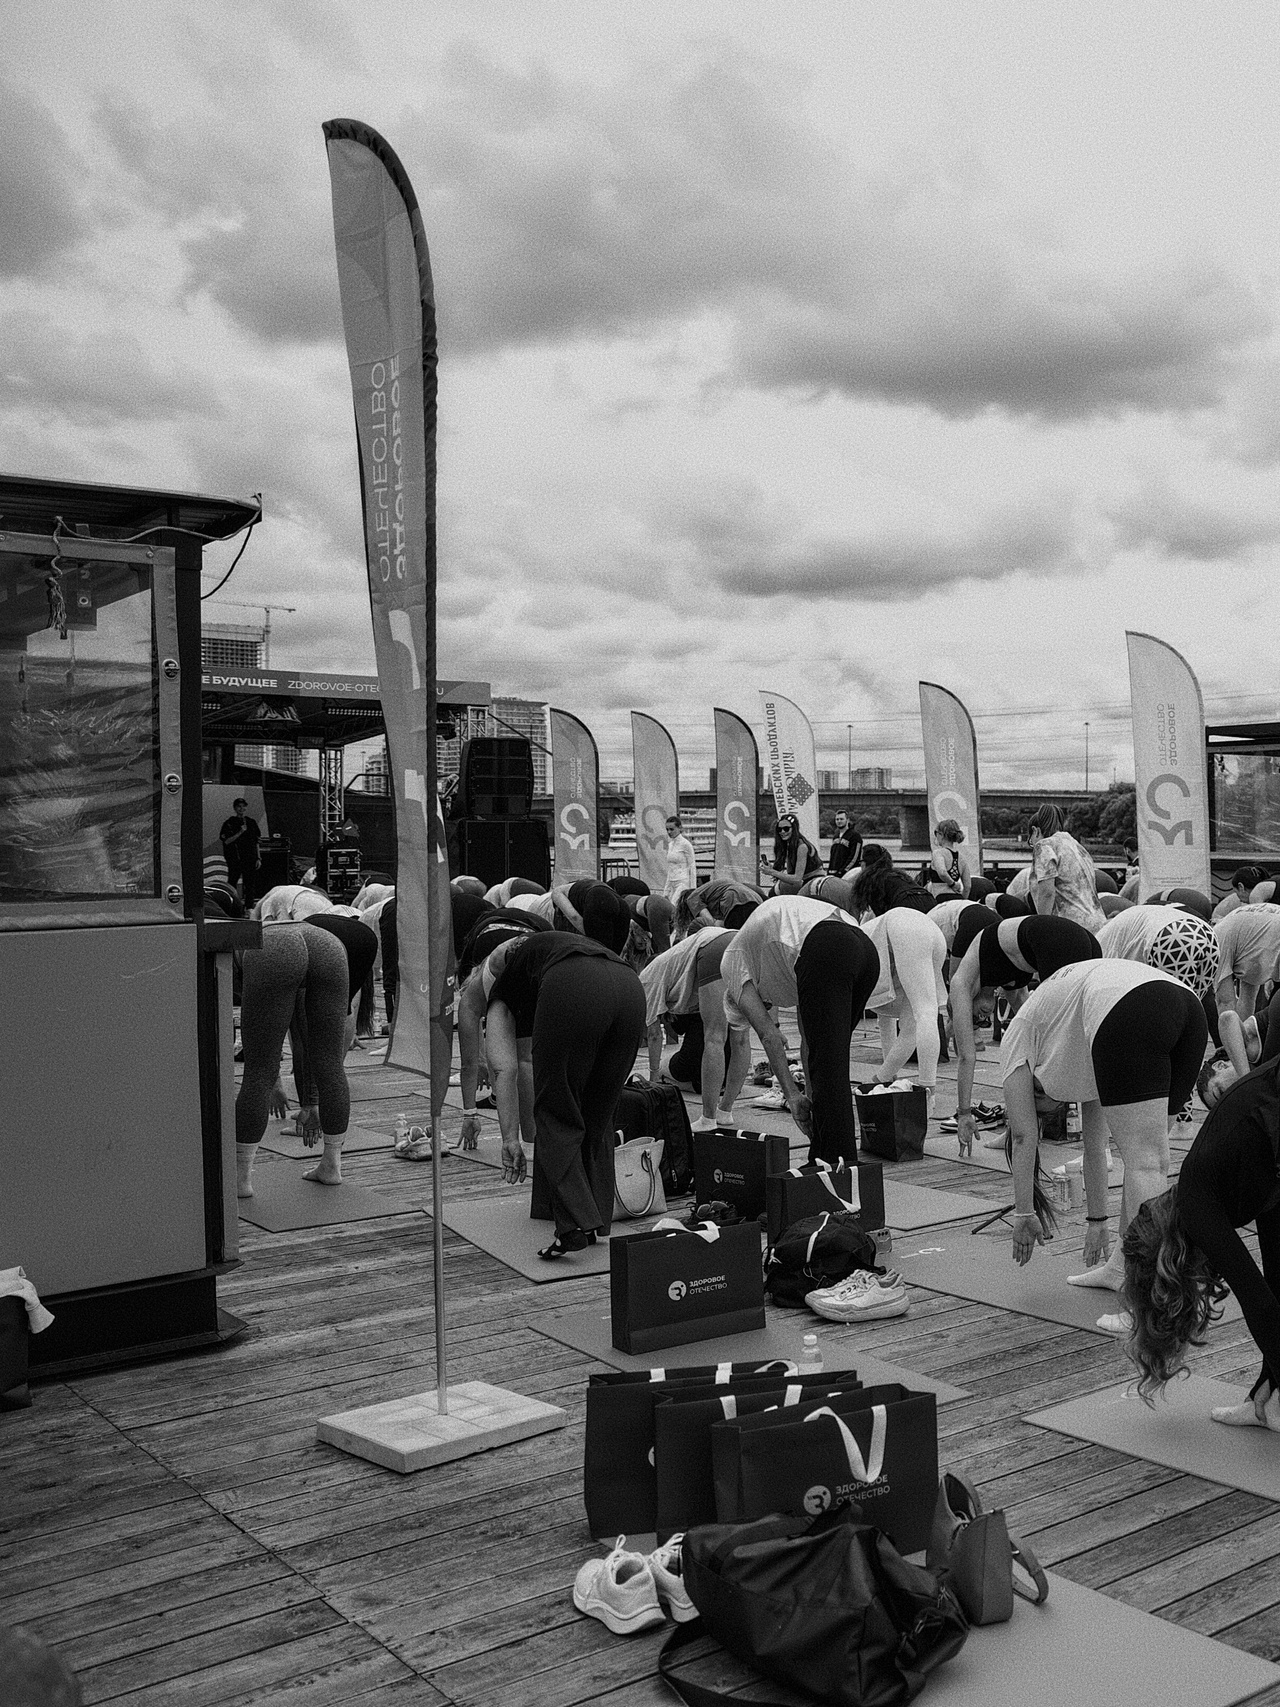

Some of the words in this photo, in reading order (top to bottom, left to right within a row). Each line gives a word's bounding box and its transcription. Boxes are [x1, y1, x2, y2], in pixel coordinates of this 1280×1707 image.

[212, 675, 278, 688] БУДУЩЕЕ
[689, 1275, 726, 1287] ЗДОРОВОЕ
[689, 1282, 728, 1295] ОТЕЧЕСТВО
